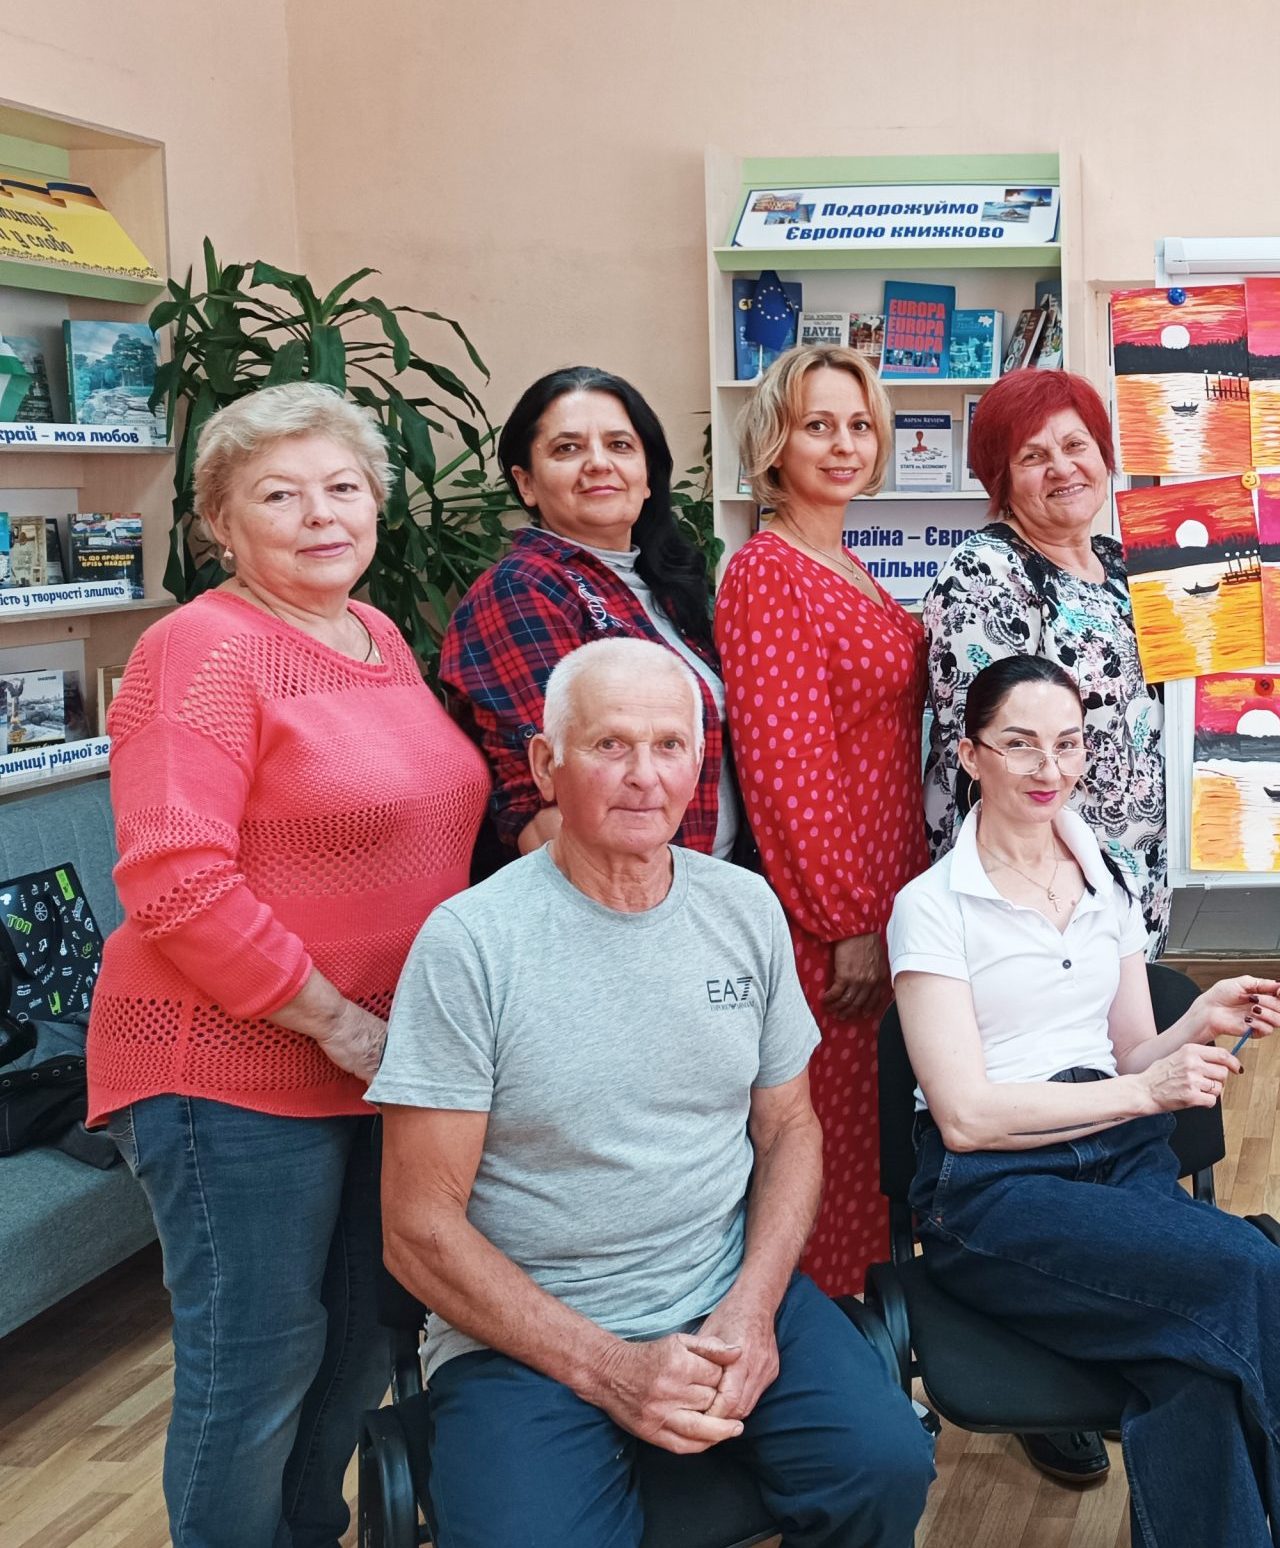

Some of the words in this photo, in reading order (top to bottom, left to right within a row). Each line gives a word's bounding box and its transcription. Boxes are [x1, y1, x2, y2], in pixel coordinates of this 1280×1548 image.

[821, 200, 979, 218] Подорожуймо
[26, 233, 74, 254] слово
[785, 226, 886, 241] Європою
[890, 226, 1005, 239] книжково
[889, 299, 946, 319] EUROPA
[803, 327, 842, 337] HAVEL
[887, 315, 945, 337] EUROPA
[886, 332, 943, 352] EUROPA
[54, 430, 86, 442] моя
[90, 428, 140, 444] любов
[861, 559, 938, 578] пільне
[22, 594, 30, 607] у
[32, 587, 82, 605] творчості
[84, 586, 125, 598] злились
[49, 743, 92, 769] рідної
[706, 976, 753, 1003] EA7
